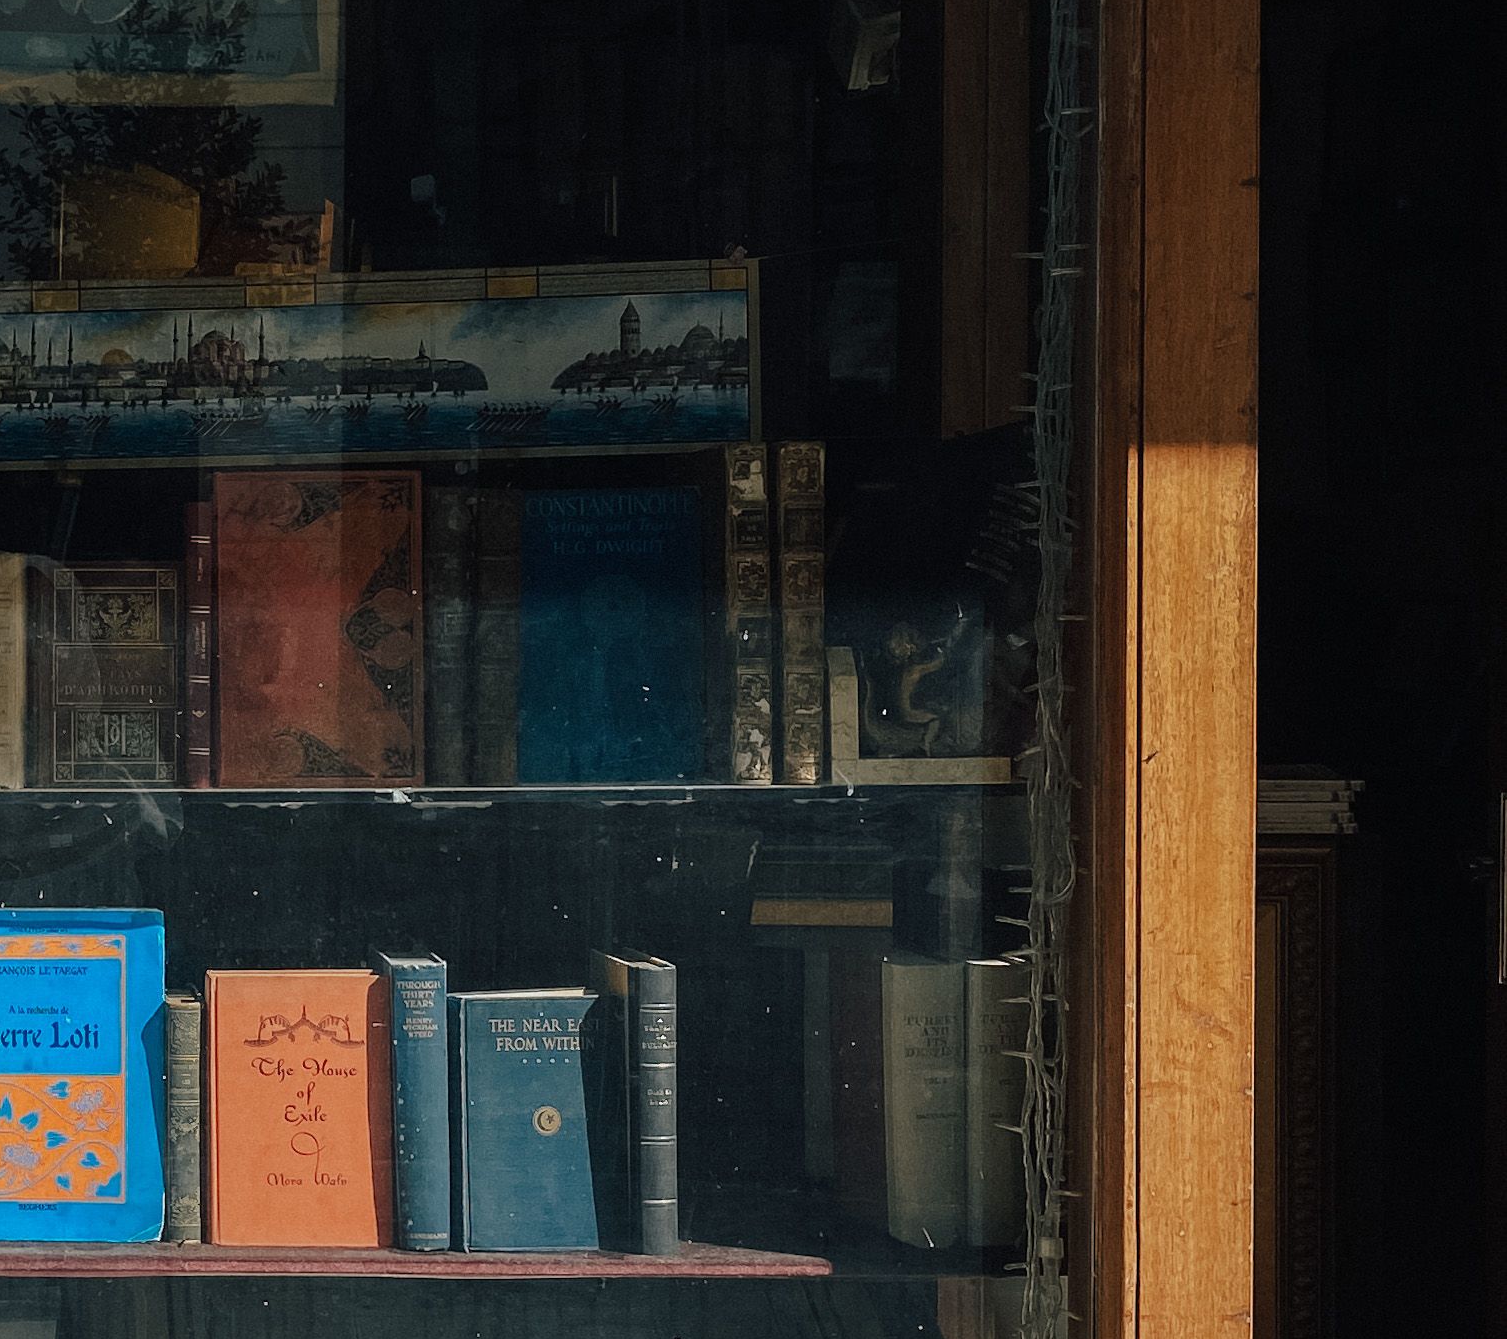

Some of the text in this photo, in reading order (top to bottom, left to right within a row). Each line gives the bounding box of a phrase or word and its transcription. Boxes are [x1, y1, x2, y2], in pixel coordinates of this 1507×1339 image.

[396, 980, 442, 990] THROUGH
[400, 990, 436, 999] THIRTY
[403, 999, 435, 1008] YEARS
[488, 1019, 516, 1033] THE
[522, 1018, 562, 1033] NEAR
[49, 1021, 100, 1049] Loti
[496, 1037, 538, 1052] FROM
[250, 1057, 358, 1083] The House
[296, 1081, 316, 1106] of
[284, 1104, 328, 1127] Exile
[267, 1172, 303, 1187] Nora
